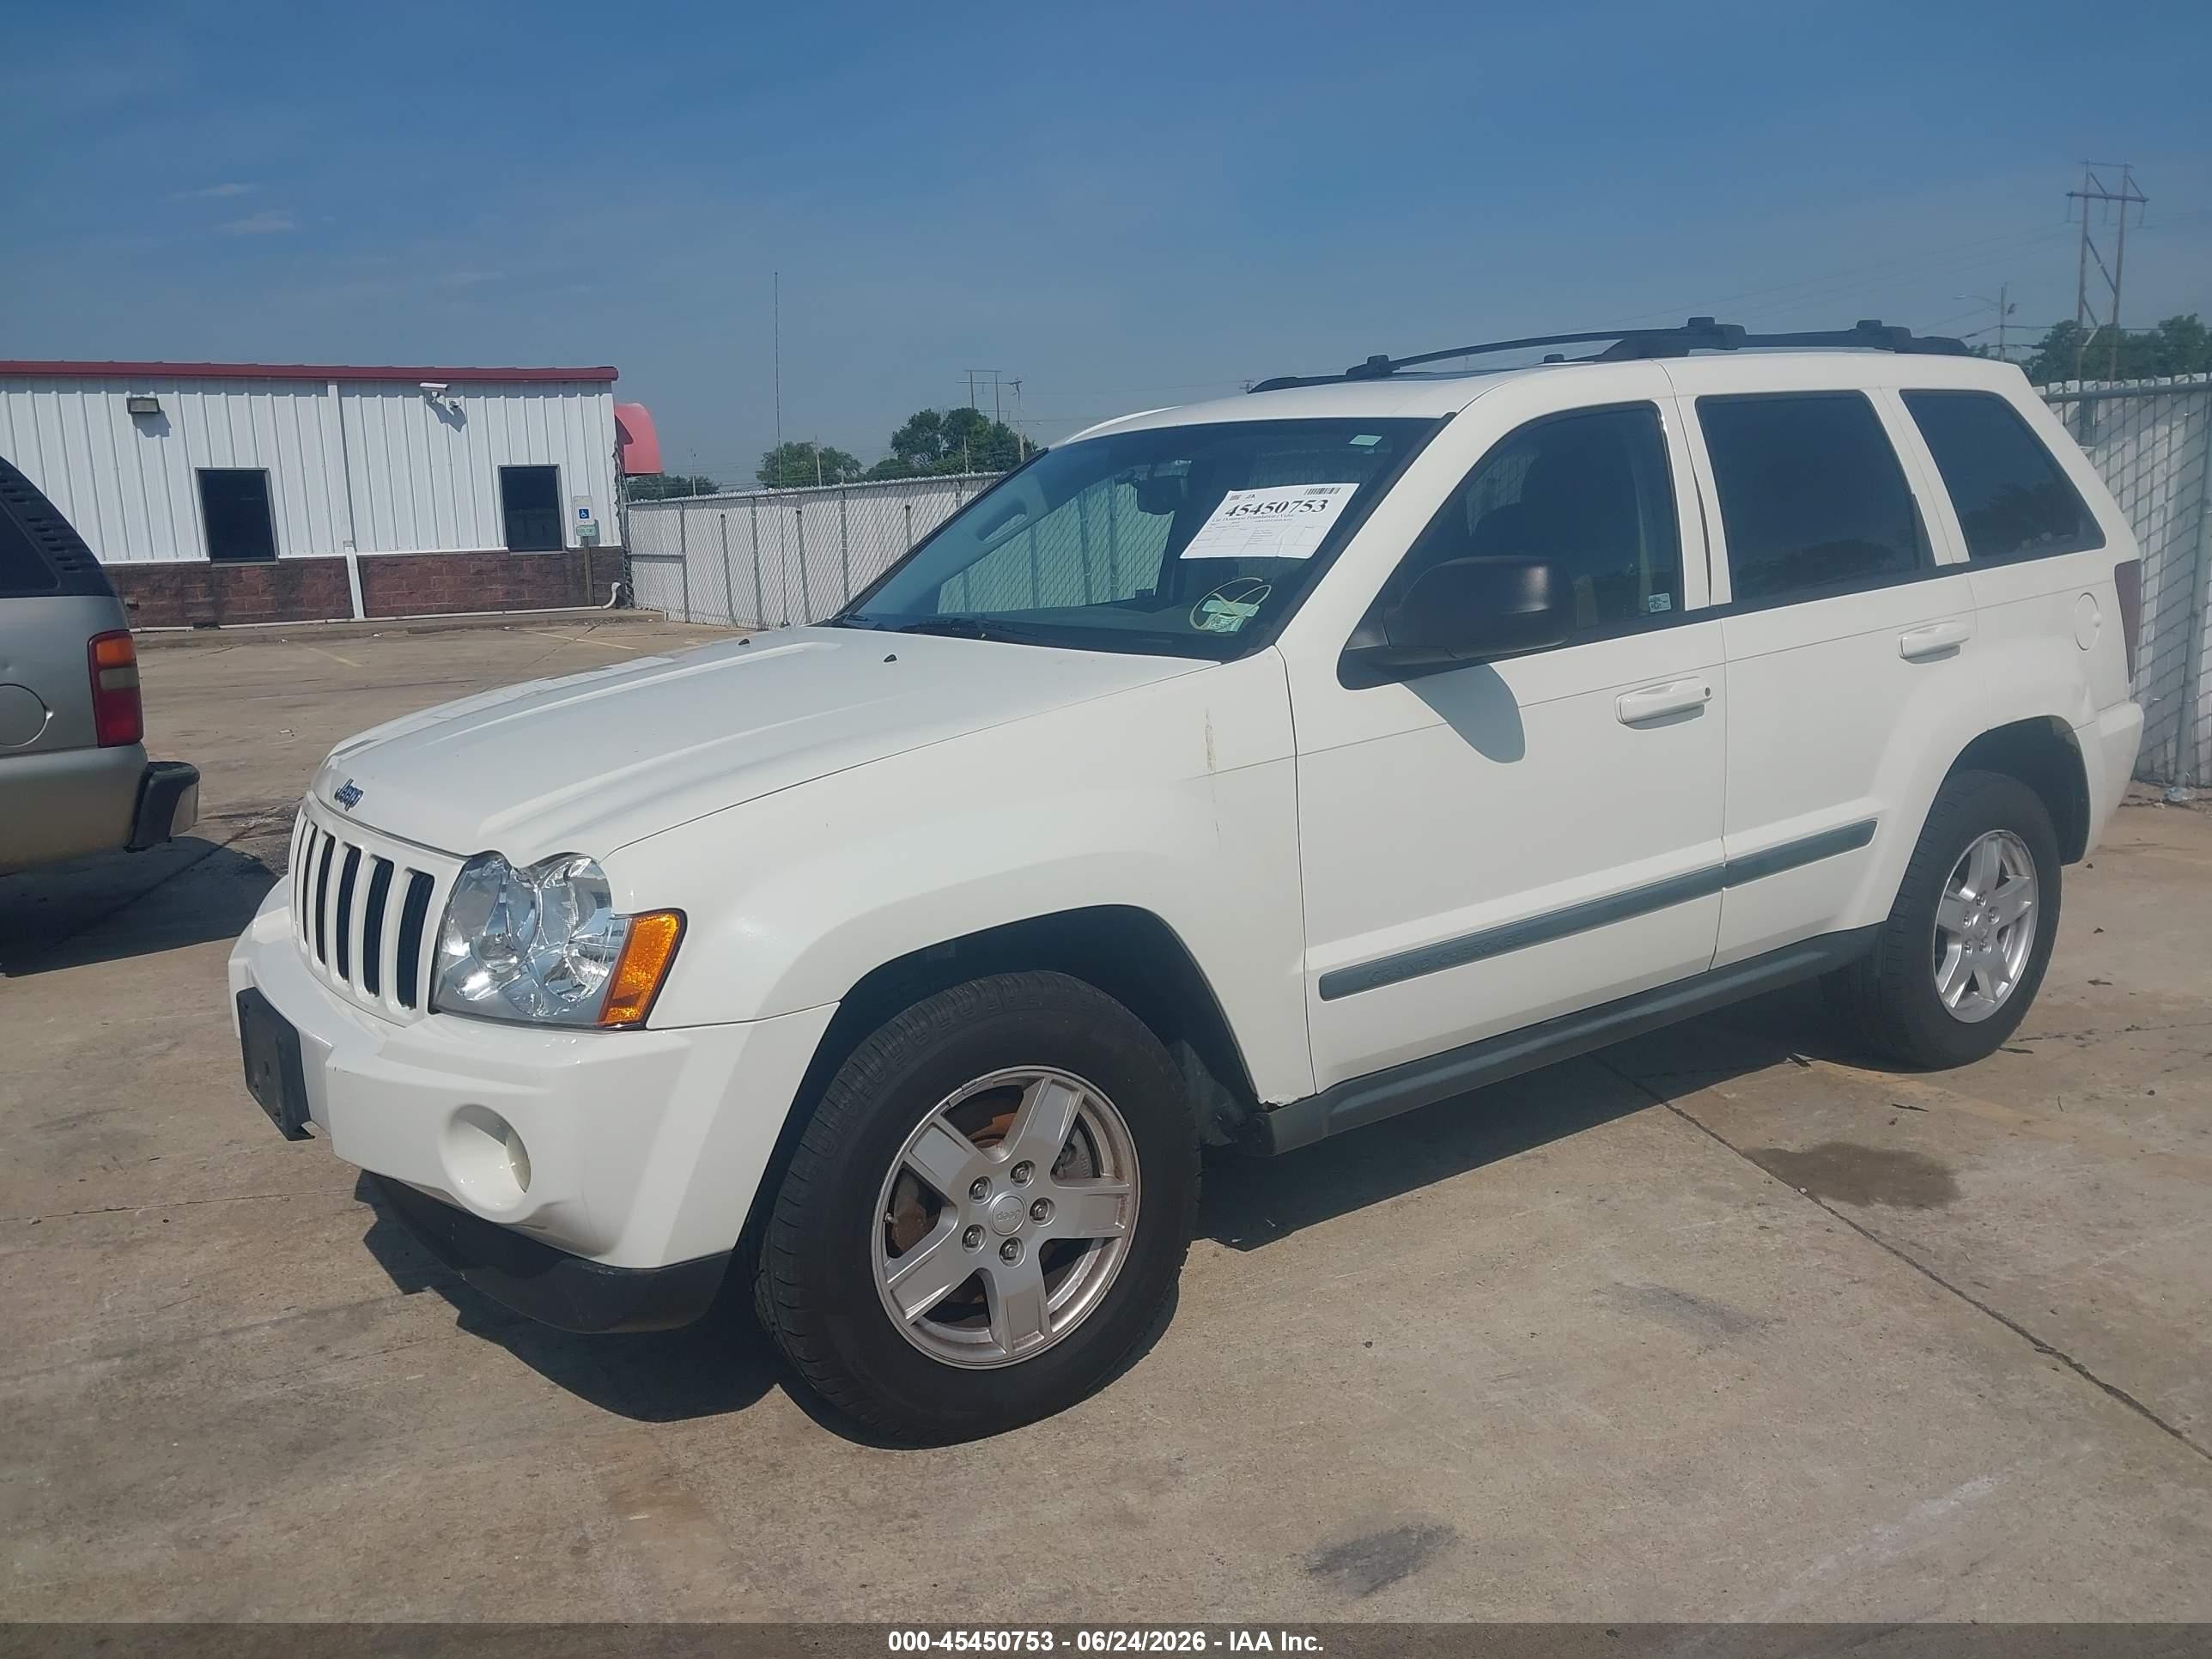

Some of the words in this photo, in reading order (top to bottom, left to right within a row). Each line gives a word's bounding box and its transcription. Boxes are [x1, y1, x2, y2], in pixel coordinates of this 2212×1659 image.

[1224, 499, 1329, 516] 45450753
[334, 778, 364, 812] Jeep
[1368, 958, 1431, 984] GRAND
[1436, 930, 1525, 965] CHEROKEE
